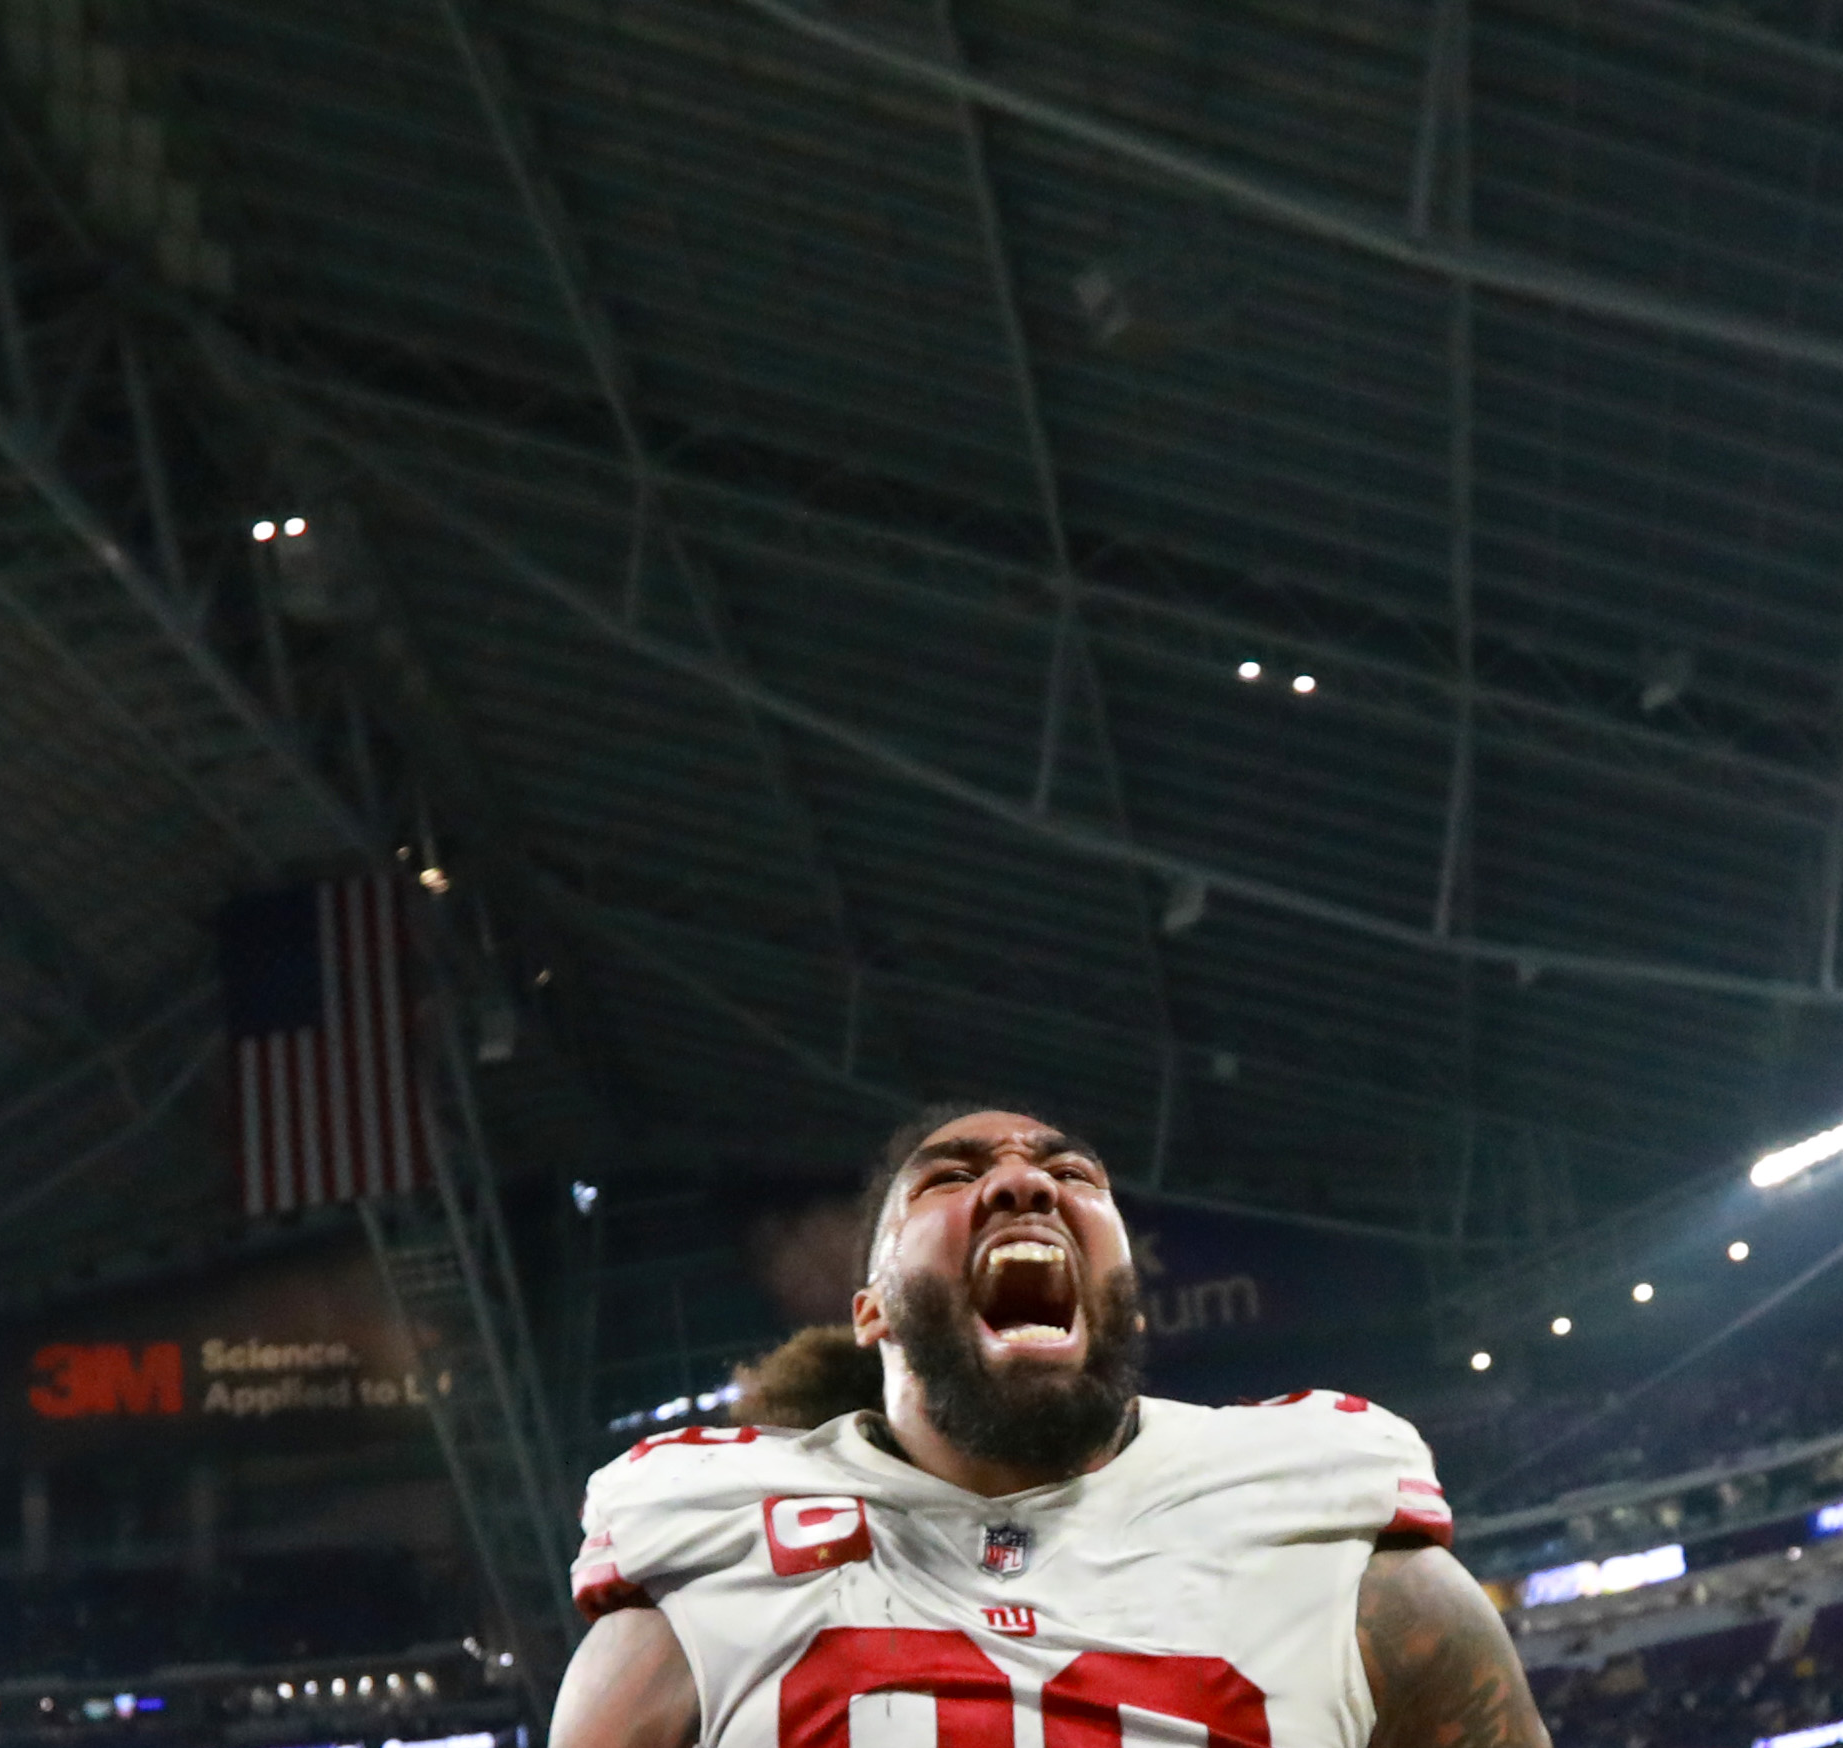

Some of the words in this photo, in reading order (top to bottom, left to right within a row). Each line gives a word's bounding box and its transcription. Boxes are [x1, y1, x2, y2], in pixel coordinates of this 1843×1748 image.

[28, 1341, 184, 1419] 3M
[203, 1378, 351, 1417] Applied
[772, 1497, 861, 1549] C
